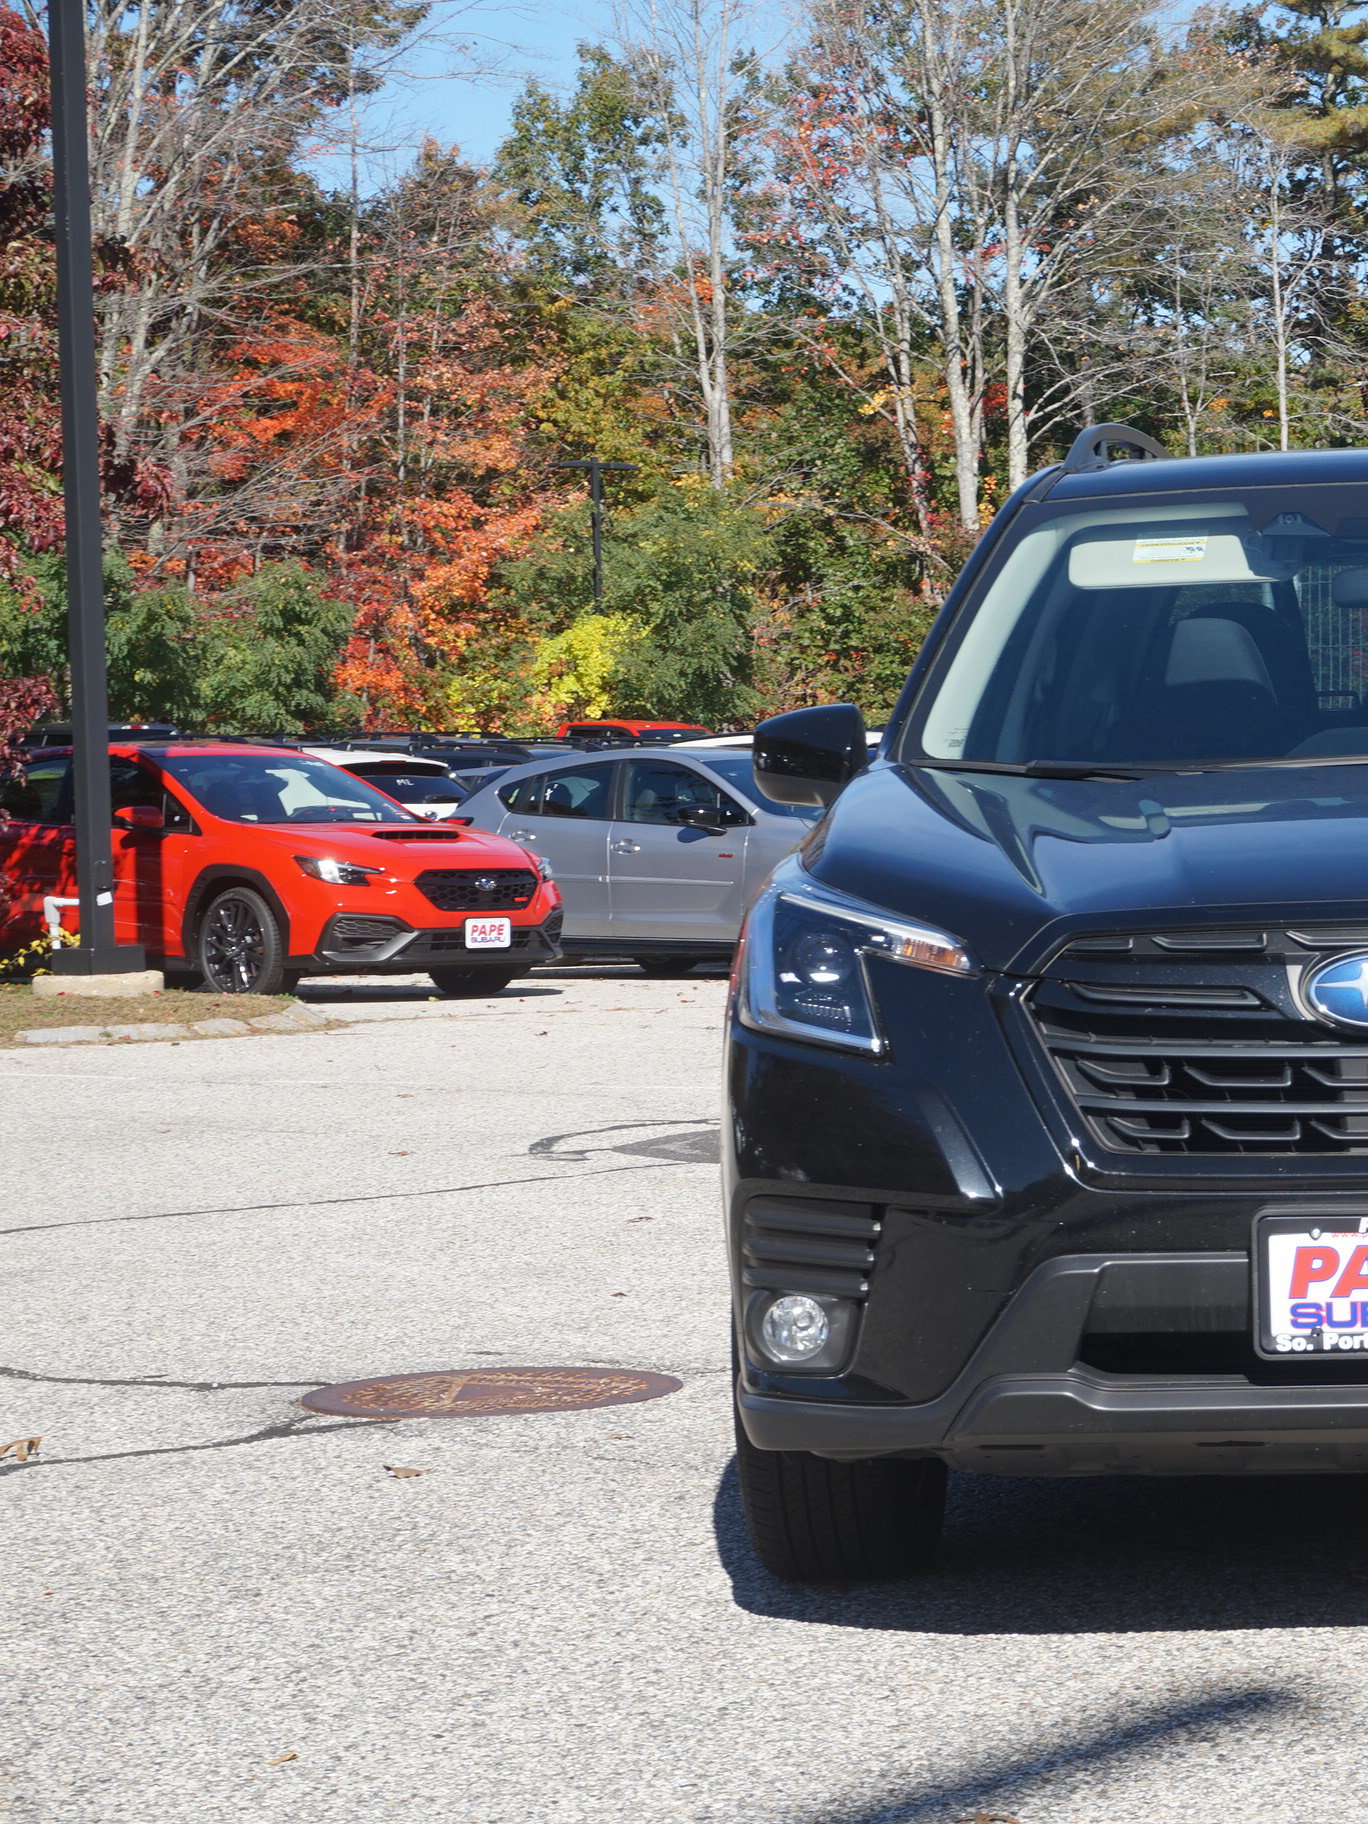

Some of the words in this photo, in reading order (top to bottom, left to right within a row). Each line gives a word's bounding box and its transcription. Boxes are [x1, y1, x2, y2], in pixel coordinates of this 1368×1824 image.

[471, 924, 505, 937] PAPE
[471, 936, 505, 944] SUBARU
[1275, 1333, 1315, 1352] So.
